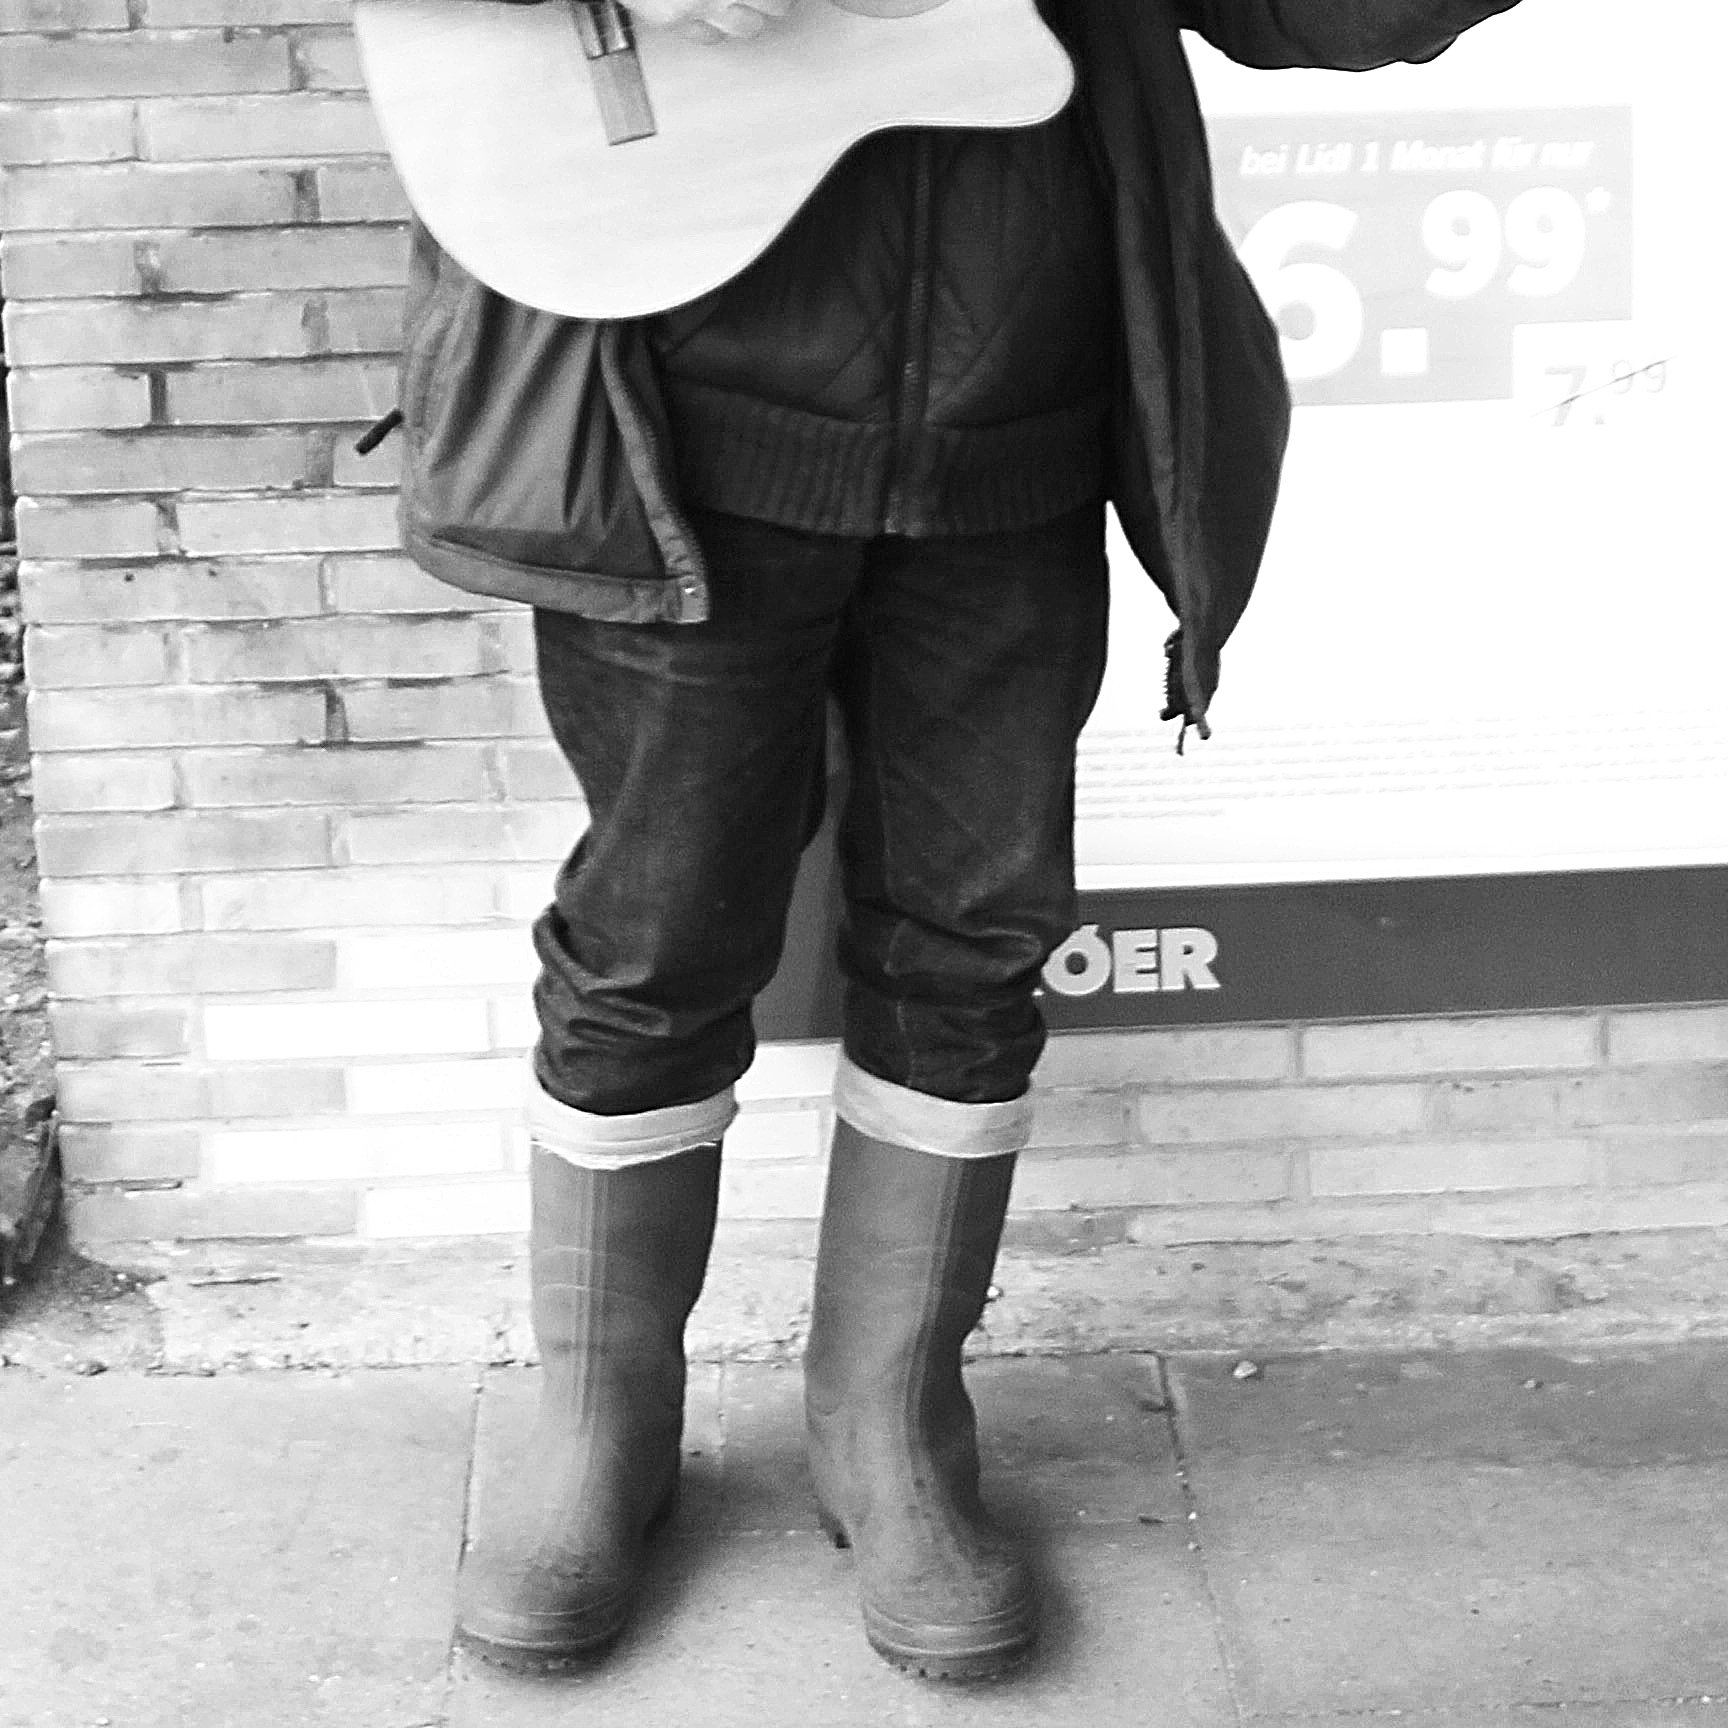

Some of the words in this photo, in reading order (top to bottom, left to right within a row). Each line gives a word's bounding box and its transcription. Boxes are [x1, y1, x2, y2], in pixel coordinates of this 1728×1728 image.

[1240, 144, 1288, 176] bei
[1294, 141, 1354, 175] Lidl
[1390, 138, 1485, 172] Monat
